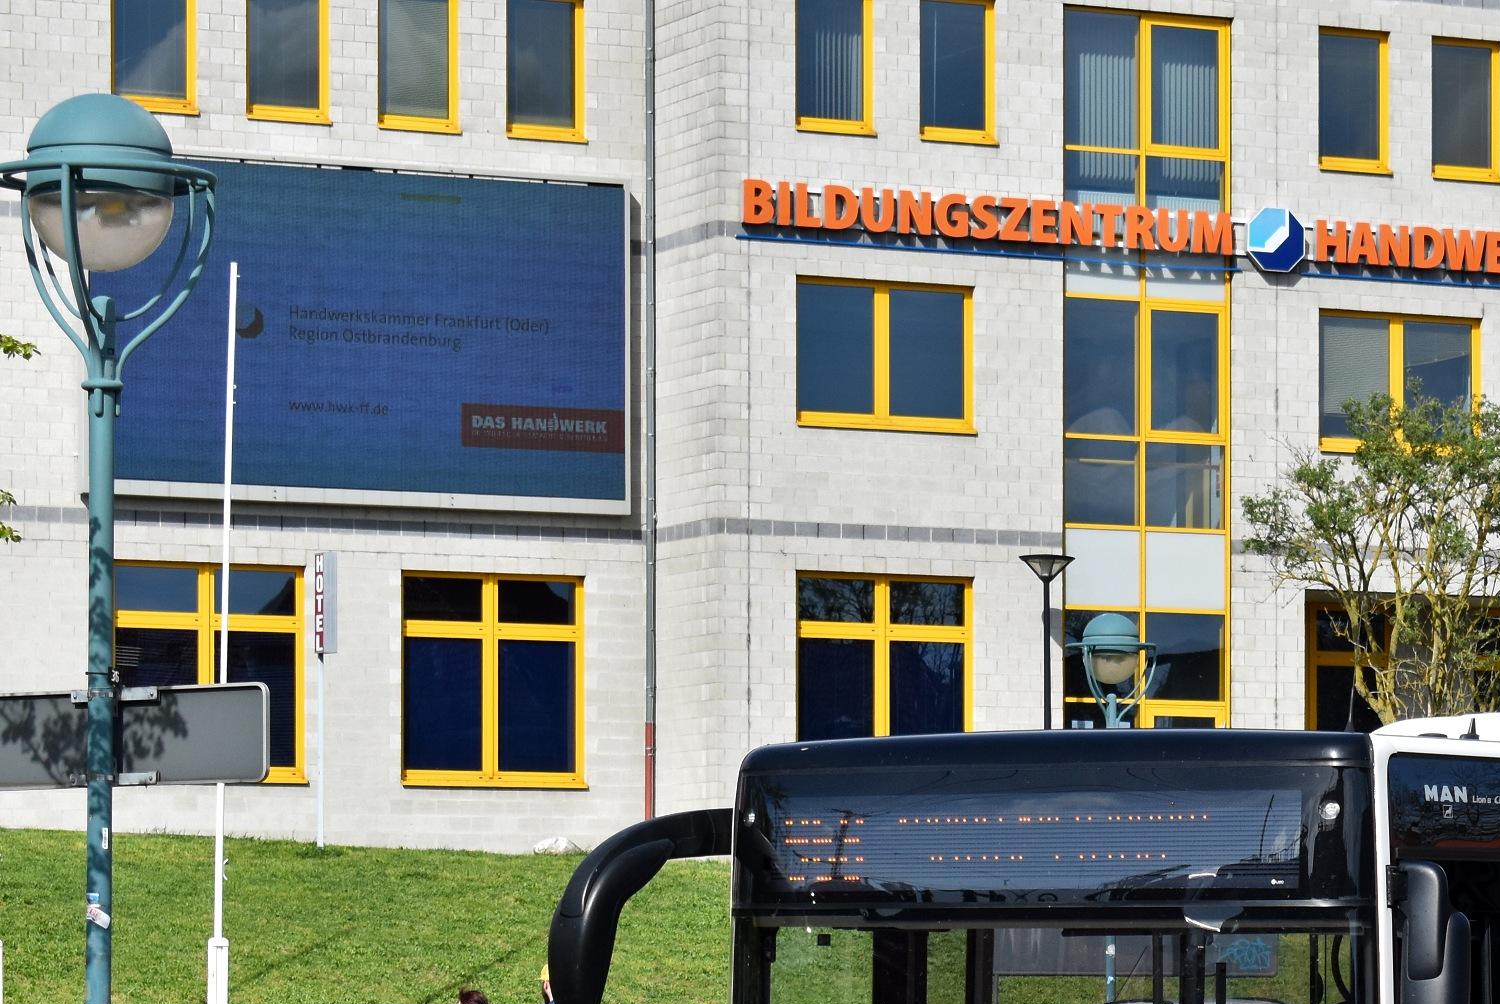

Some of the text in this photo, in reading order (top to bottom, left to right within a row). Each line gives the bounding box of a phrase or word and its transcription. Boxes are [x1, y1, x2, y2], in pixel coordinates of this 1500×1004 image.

[743, 178, 1234, 256] BILDUNGSZENTRUM
[288, 305, 550, 335] Handwerkskammer Frankfurt (Oder)
[289, 326, 464, 352] Region Ostbrandenburg
[471, 412, 608, 433] DAS HANDWERK
[315, 554, 324, 652] HOTEL
[1424, 784, 1468, 803] MAN
